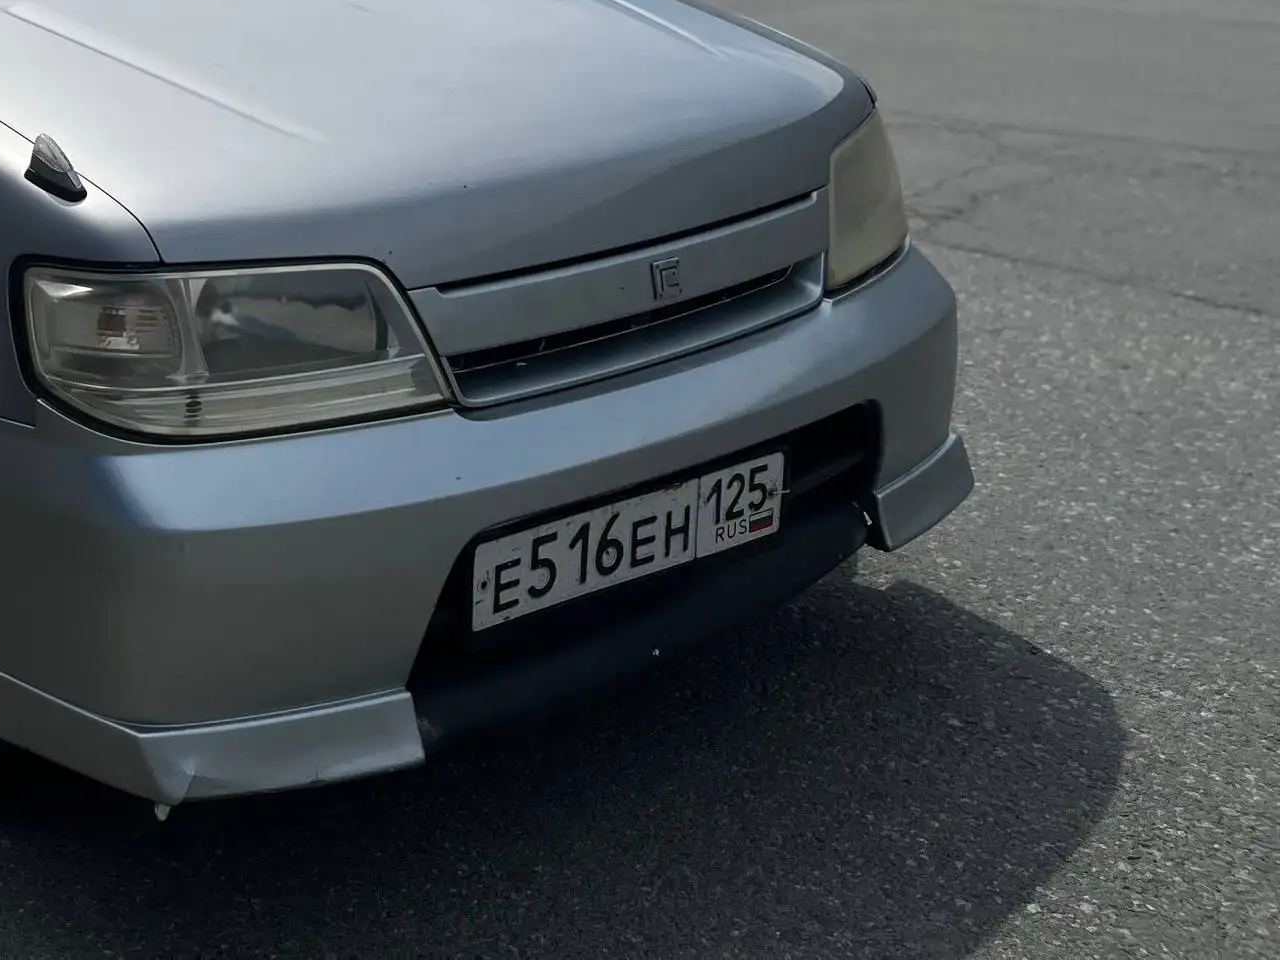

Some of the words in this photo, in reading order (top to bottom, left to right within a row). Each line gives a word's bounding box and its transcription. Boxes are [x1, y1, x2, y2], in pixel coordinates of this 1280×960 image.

[493, 505, 691, 614] E516EH
[706, 463, 768, 526] 125
[715, 520, 748, 543] RUS
